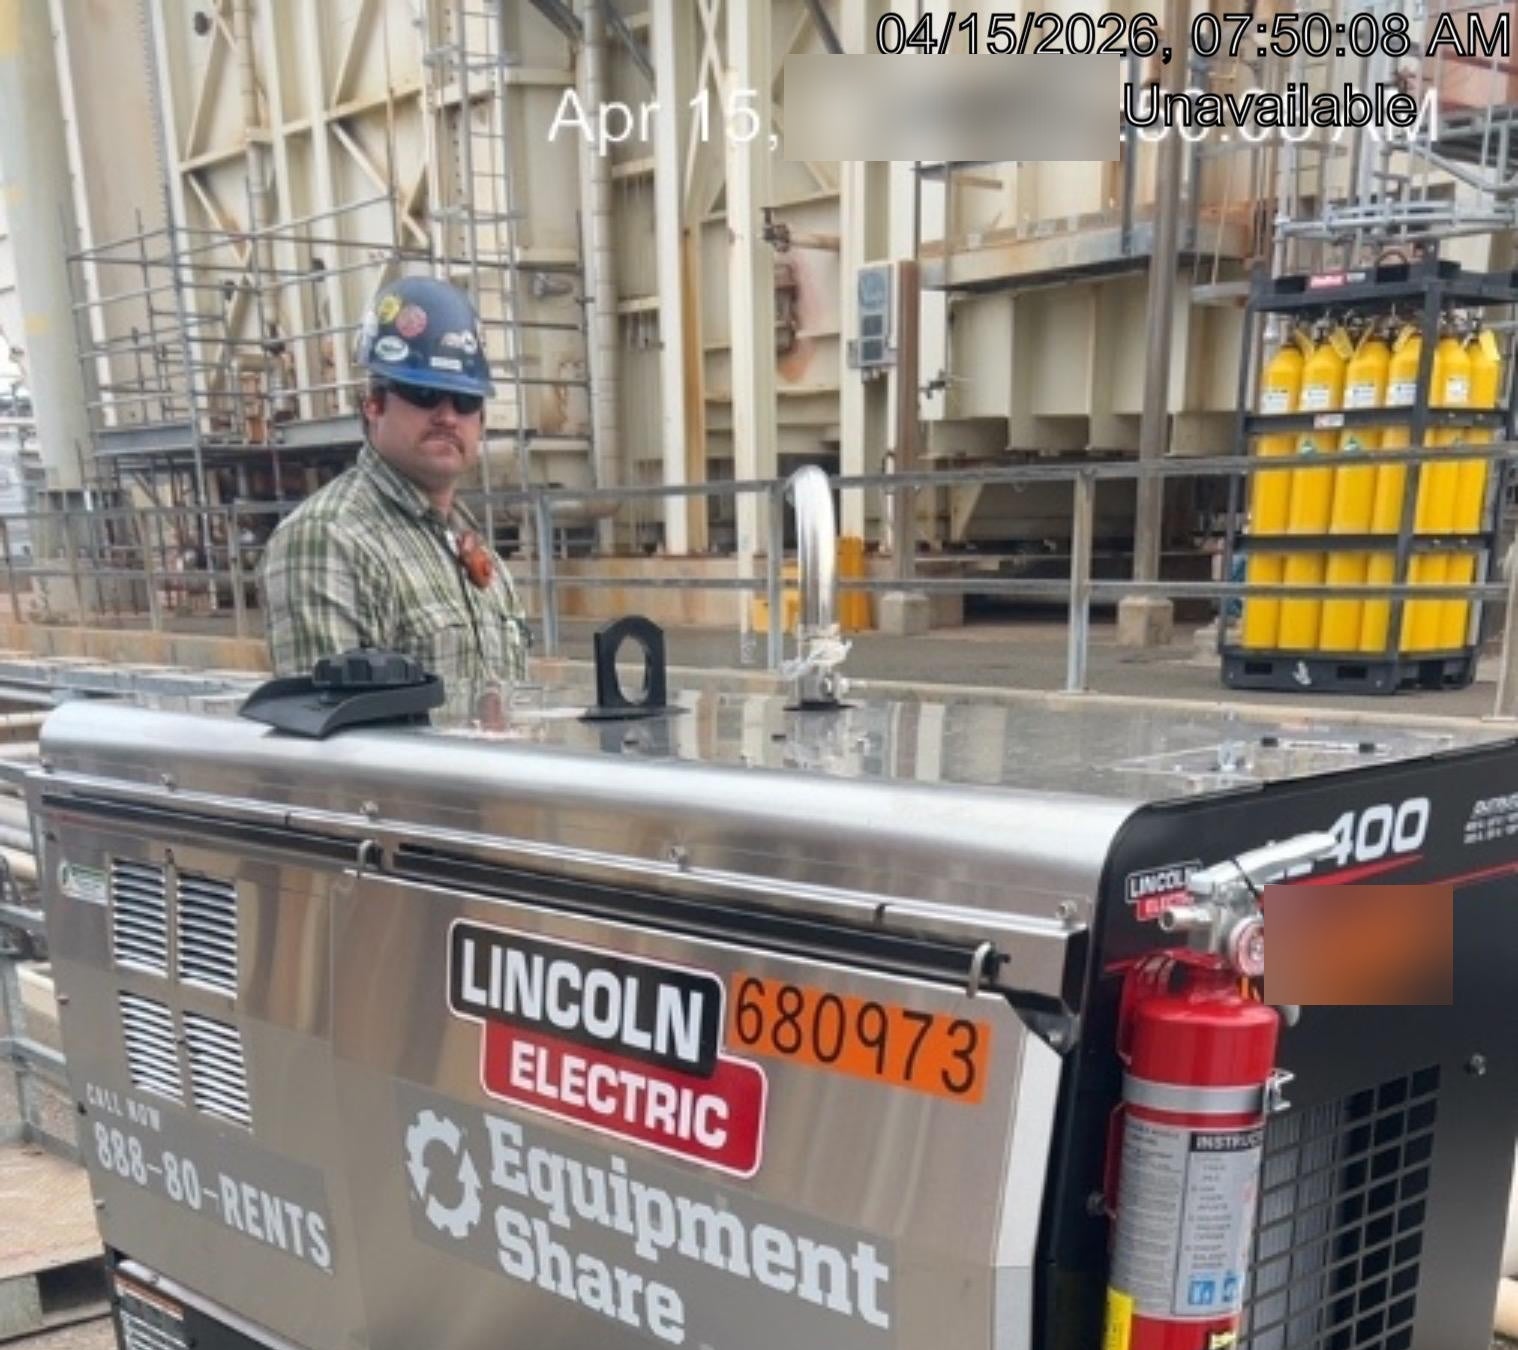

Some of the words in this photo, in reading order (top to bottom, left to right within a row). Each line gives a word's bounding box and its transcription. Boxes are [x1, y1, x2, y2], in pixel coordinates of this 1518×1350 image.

[461, 938, 703, 1063] LINCOLN
[736, 977, 979, 1094] 680973
[87, 1082, 123, 1117] CALL
[509, 1039, 730, 1149] ELECTRIC
[94, 1121, 332, 1268] 888-80-RENTS
[484, 1114, 890, 1329] Equipment
[495, 1205, 685, 1345] Share
